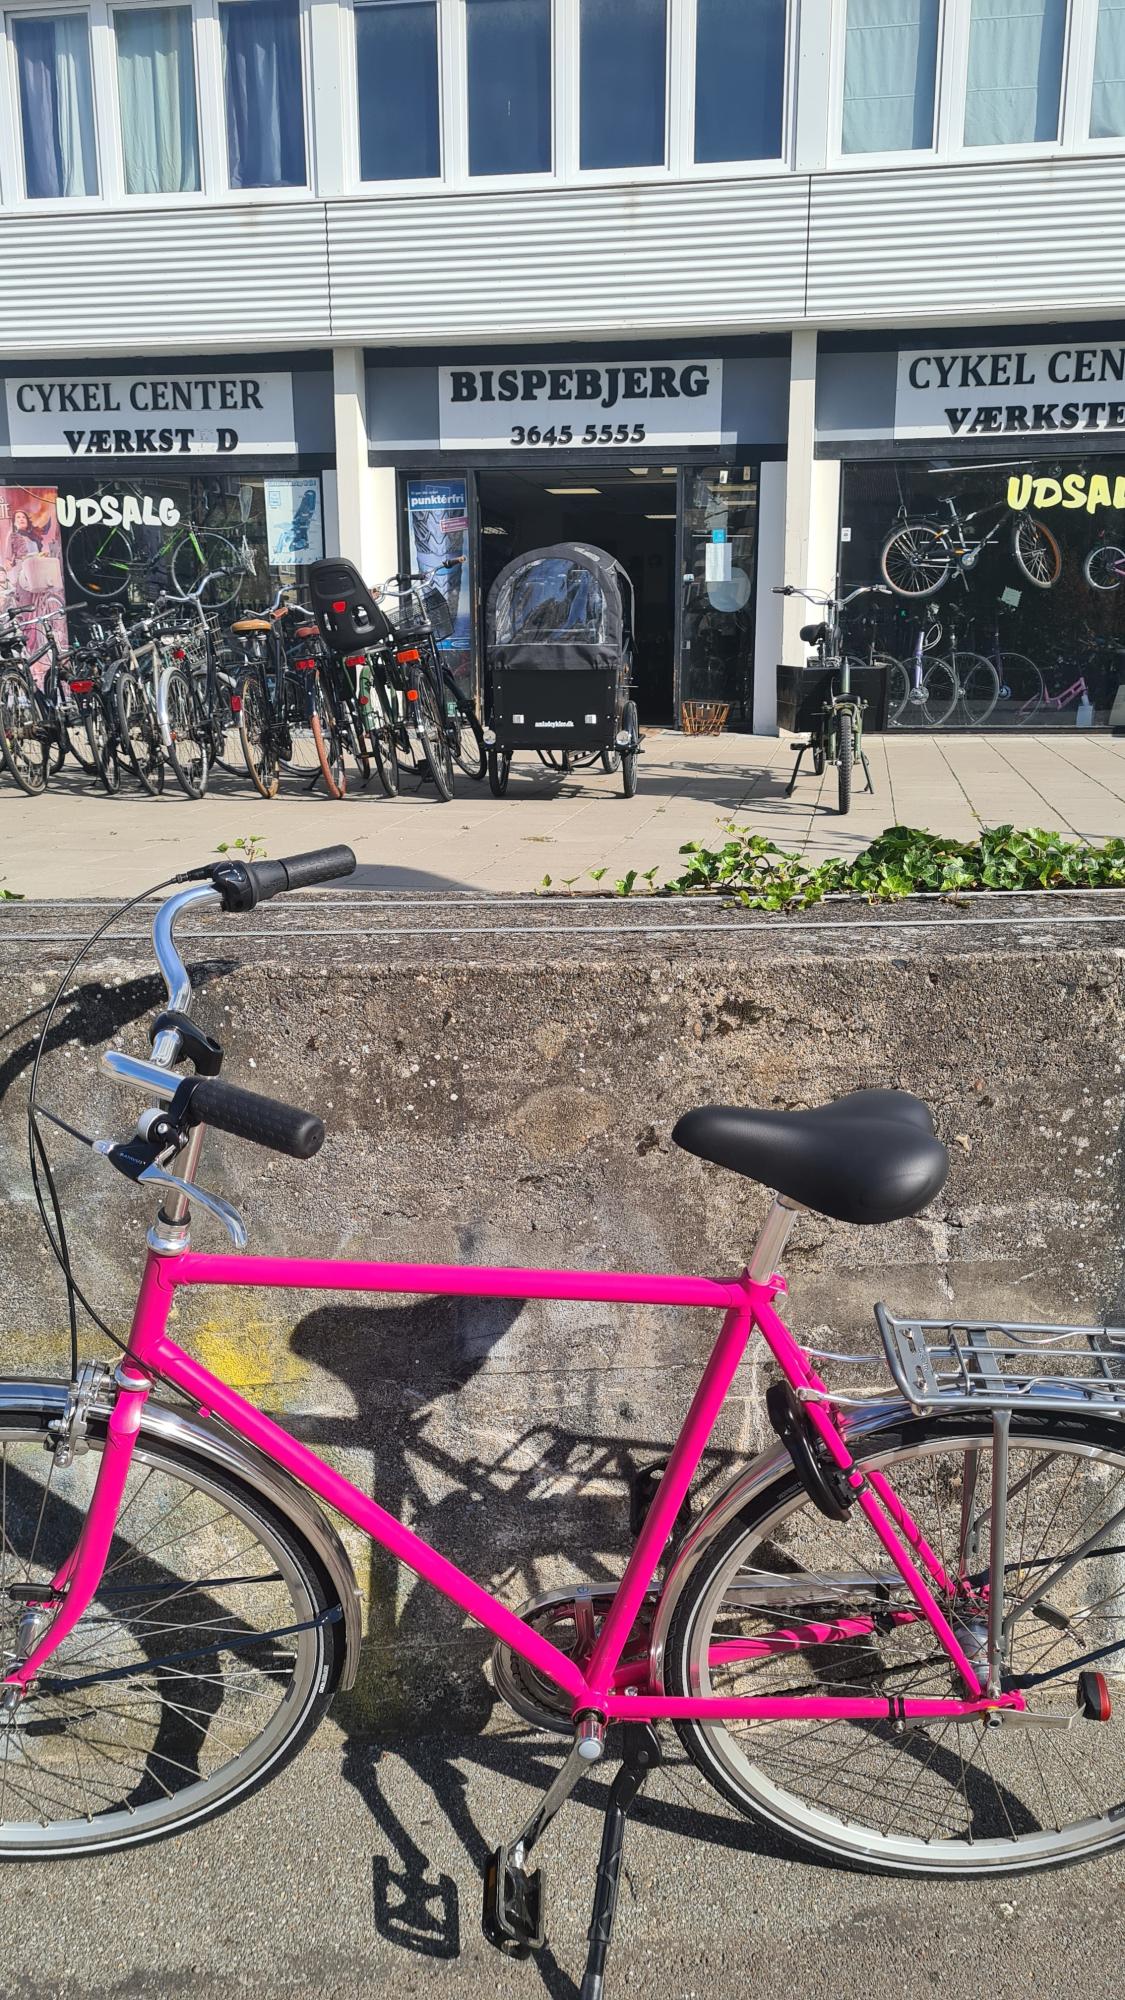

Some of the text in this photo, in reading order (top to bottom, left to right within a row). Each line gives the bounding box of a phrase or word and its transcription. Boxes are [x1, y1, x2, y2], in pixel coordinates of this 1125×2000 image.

[450, 365, 710, 408] BISPEBJERG
[908, 353, 1036, 389] CYKEL
[16, 379, 264, 413] CYKEL CENTER
[510, 423, 646, 447] 3645 5555
[944, 401, 1125, 435] VÆRKSTE
[56, 495, 181, 531] UDSALG
